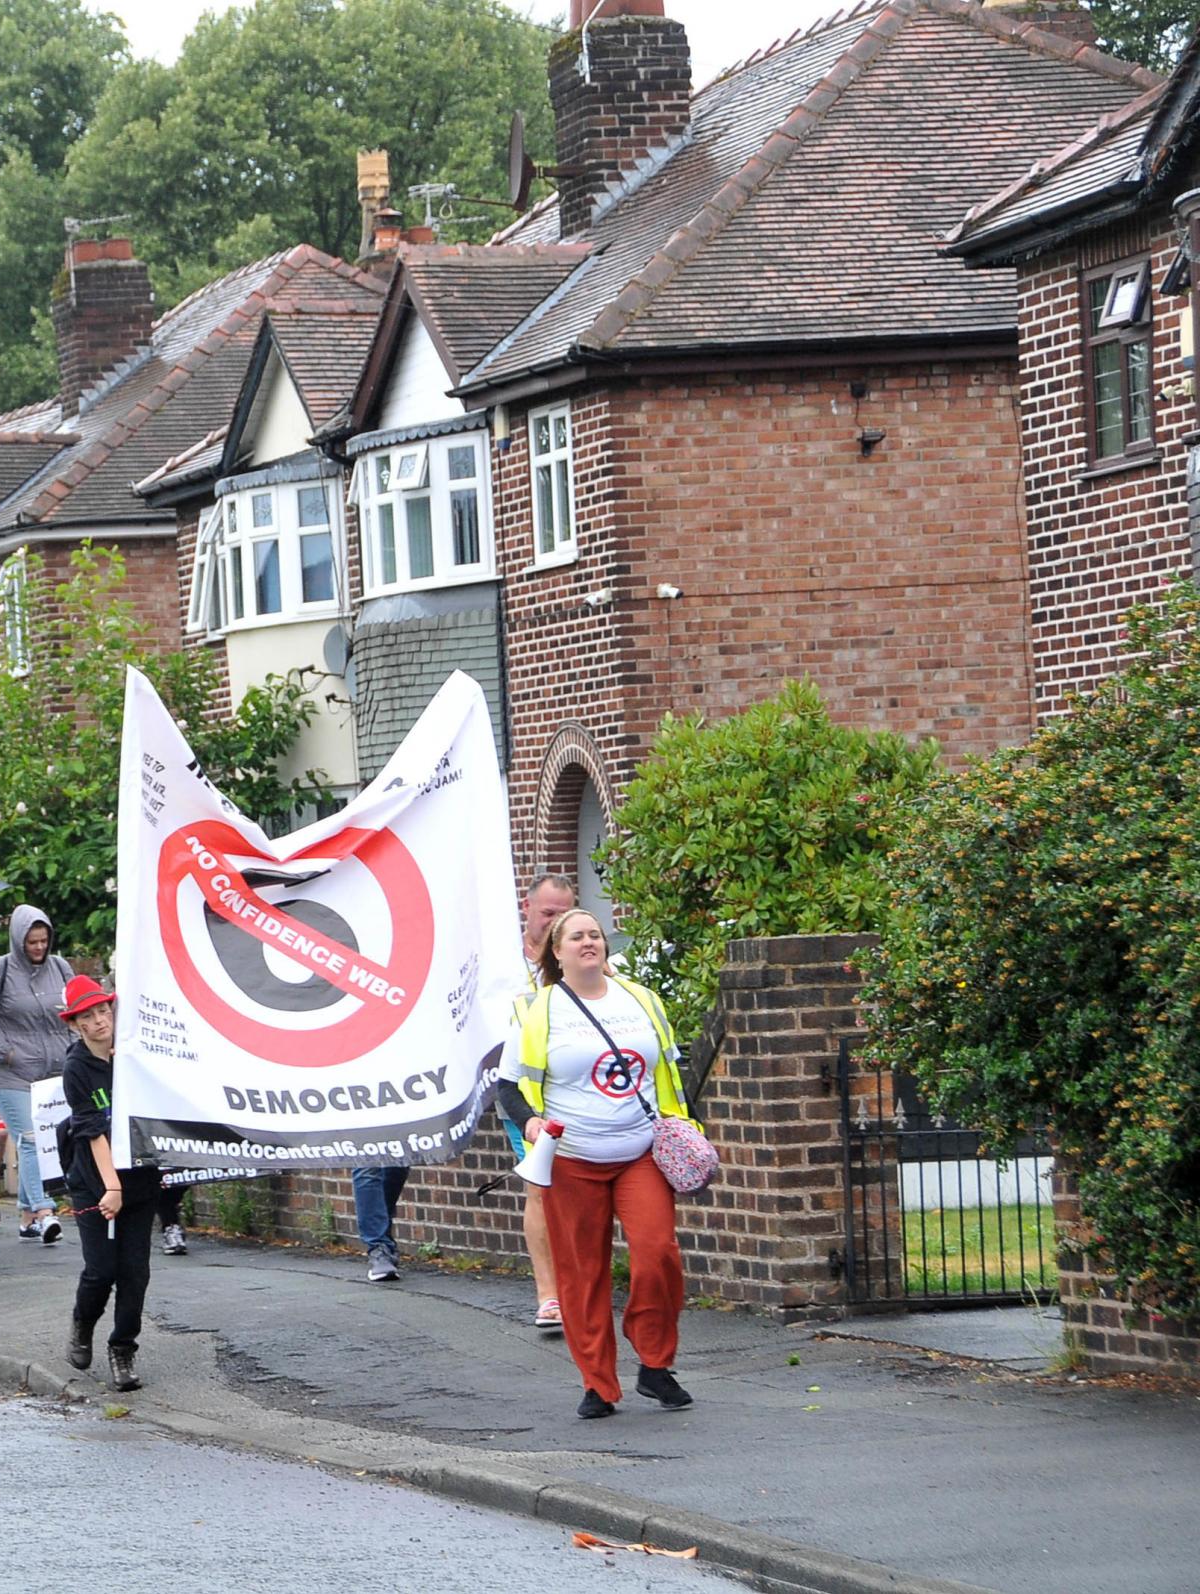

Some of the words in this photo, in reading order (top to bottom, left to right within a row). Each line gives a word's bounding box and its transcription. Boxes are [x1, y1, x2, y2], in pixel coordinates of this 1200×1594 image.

[152, 760, 165, 773] TO
[435, 768, 463, 790] JAM!
[184, 835, 218, 870] NO
[210, 874, 347, 974] CONFIDENCE
[347, 965, 406, 1006] WBC
[152, 1001, 168, 1013] NOT
[171, 1006, 177, 1015] A
[159, 1032, 178, 1044] JUST
[182, 1036, 188, 1045] A
[177, 1050, 199, 1062] JAM!
[222, 1065, 448, 1115] DEMOCRACY
[151, 1135, 405, 1159] www.notocentral6.org
[407, 1132, 444, 1152] for
